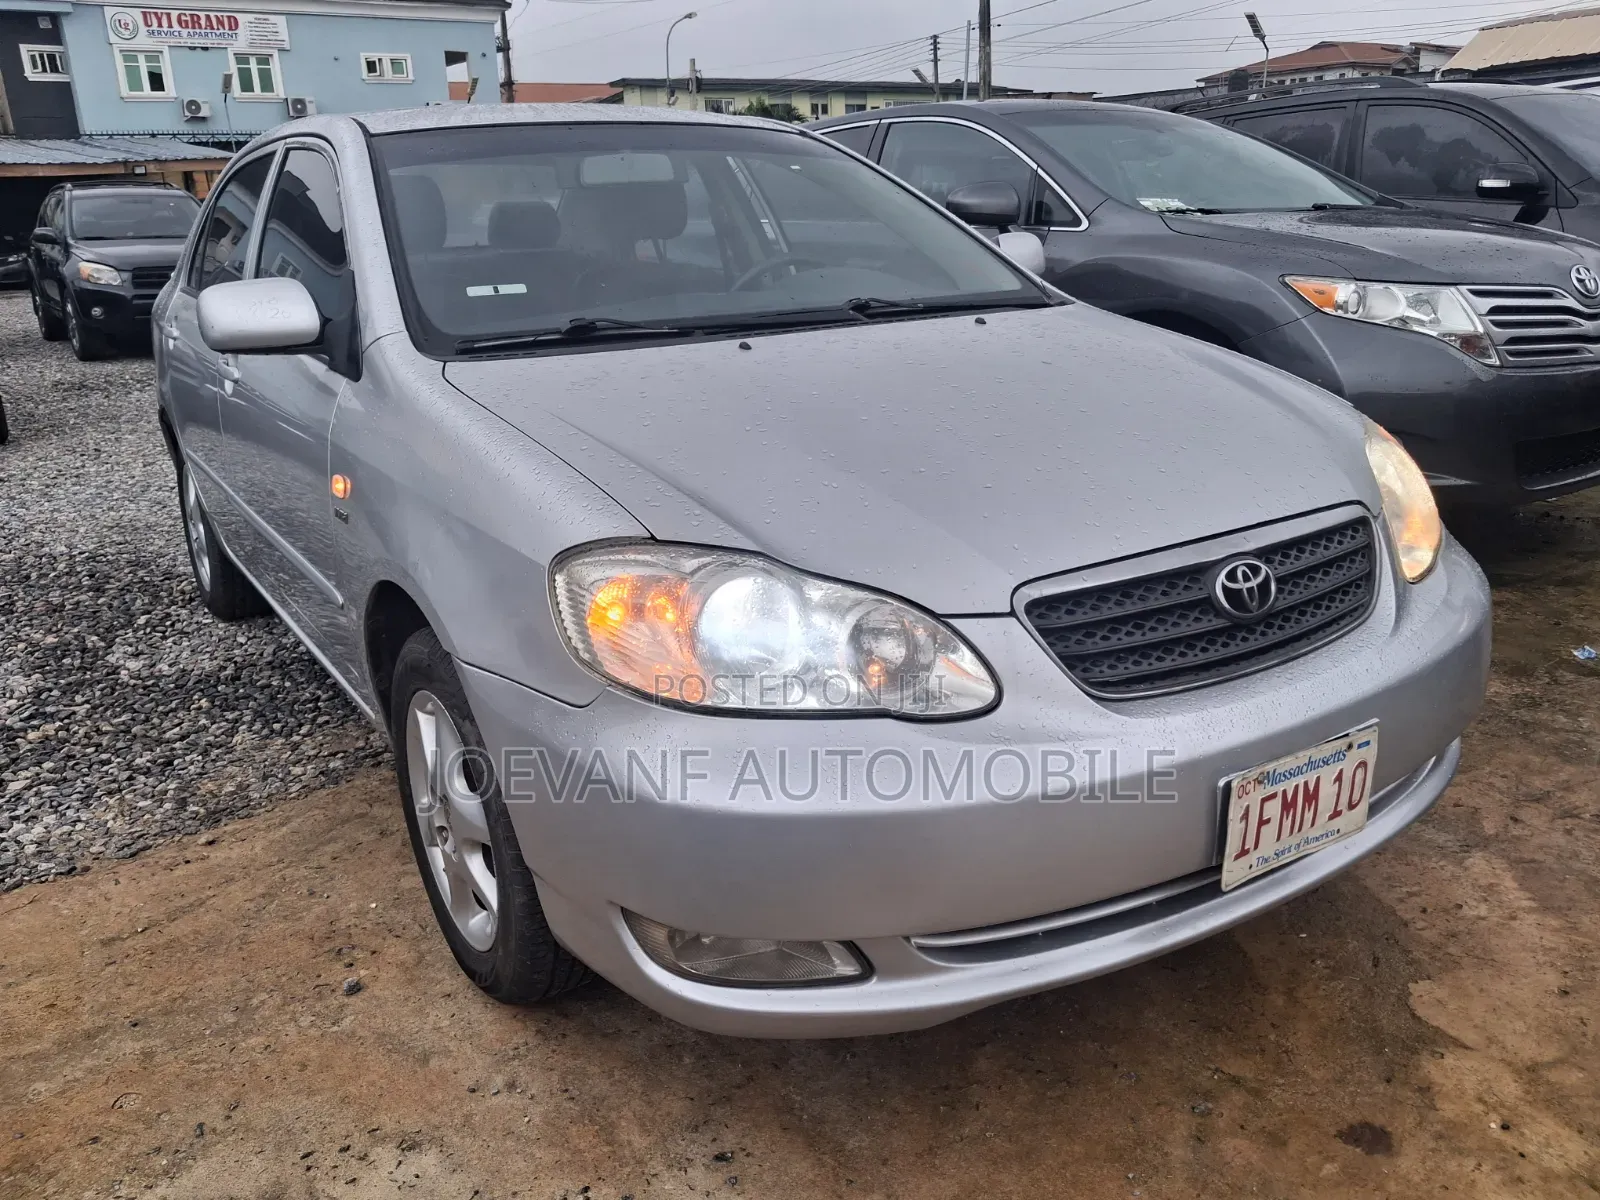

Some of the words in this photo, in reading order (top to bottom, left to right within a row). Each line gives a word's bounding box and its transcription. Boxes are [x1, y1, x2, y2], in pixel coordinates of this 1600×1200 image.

[141, 10, 174, 29] UYI
[176, 12, 239, 31] GRAND
[146, 29, 184, 38] SERVICE
[186, 30, 239, 40] APARTMENT
[1237, 779, 1257, 799] OCT
[1263, 747, 1347, 790] Massachusetts
[1232, 775, 1321, 862] 1FMM
[1326, 760, 1368, 822] 10
[1256, 854, 1271, 868] The
[1272, 844, 1292, 862] Spirit
[1302, 829, 1336, 848] America
